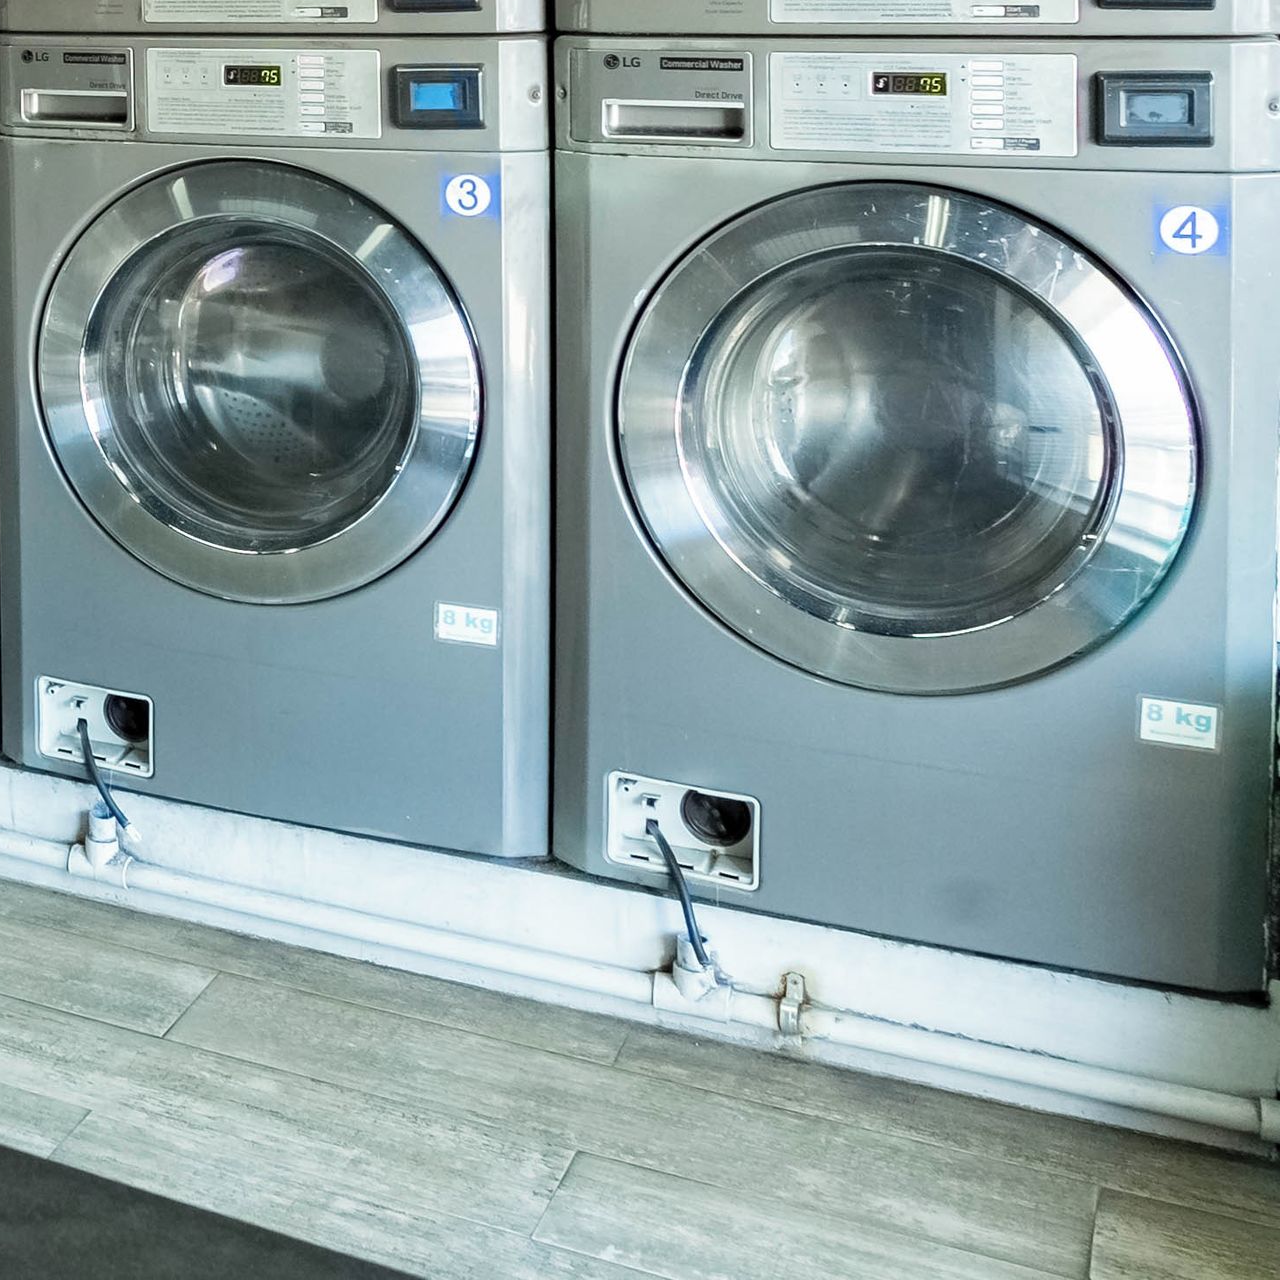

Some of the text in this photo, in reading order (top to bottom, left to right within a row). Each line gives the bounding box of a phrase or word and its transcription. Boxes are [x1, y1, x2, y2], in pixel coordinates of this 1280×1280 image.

[35, 52, 49, 62] LG
[622, 57, 641, 68] LG
[662, 59, 742, 69] Commercial Washer
[261, 69, 278, 83] 75
[920, 78, 942, 93] 75
[694, 90, 743, 100] Direct Drive
[458, 178, 477, 210] 3
[1172, 211, 1203, 249] 4
[443, 609, 493, 634] 8 kg
[1148, 703, 1212, 733] 8 kg
